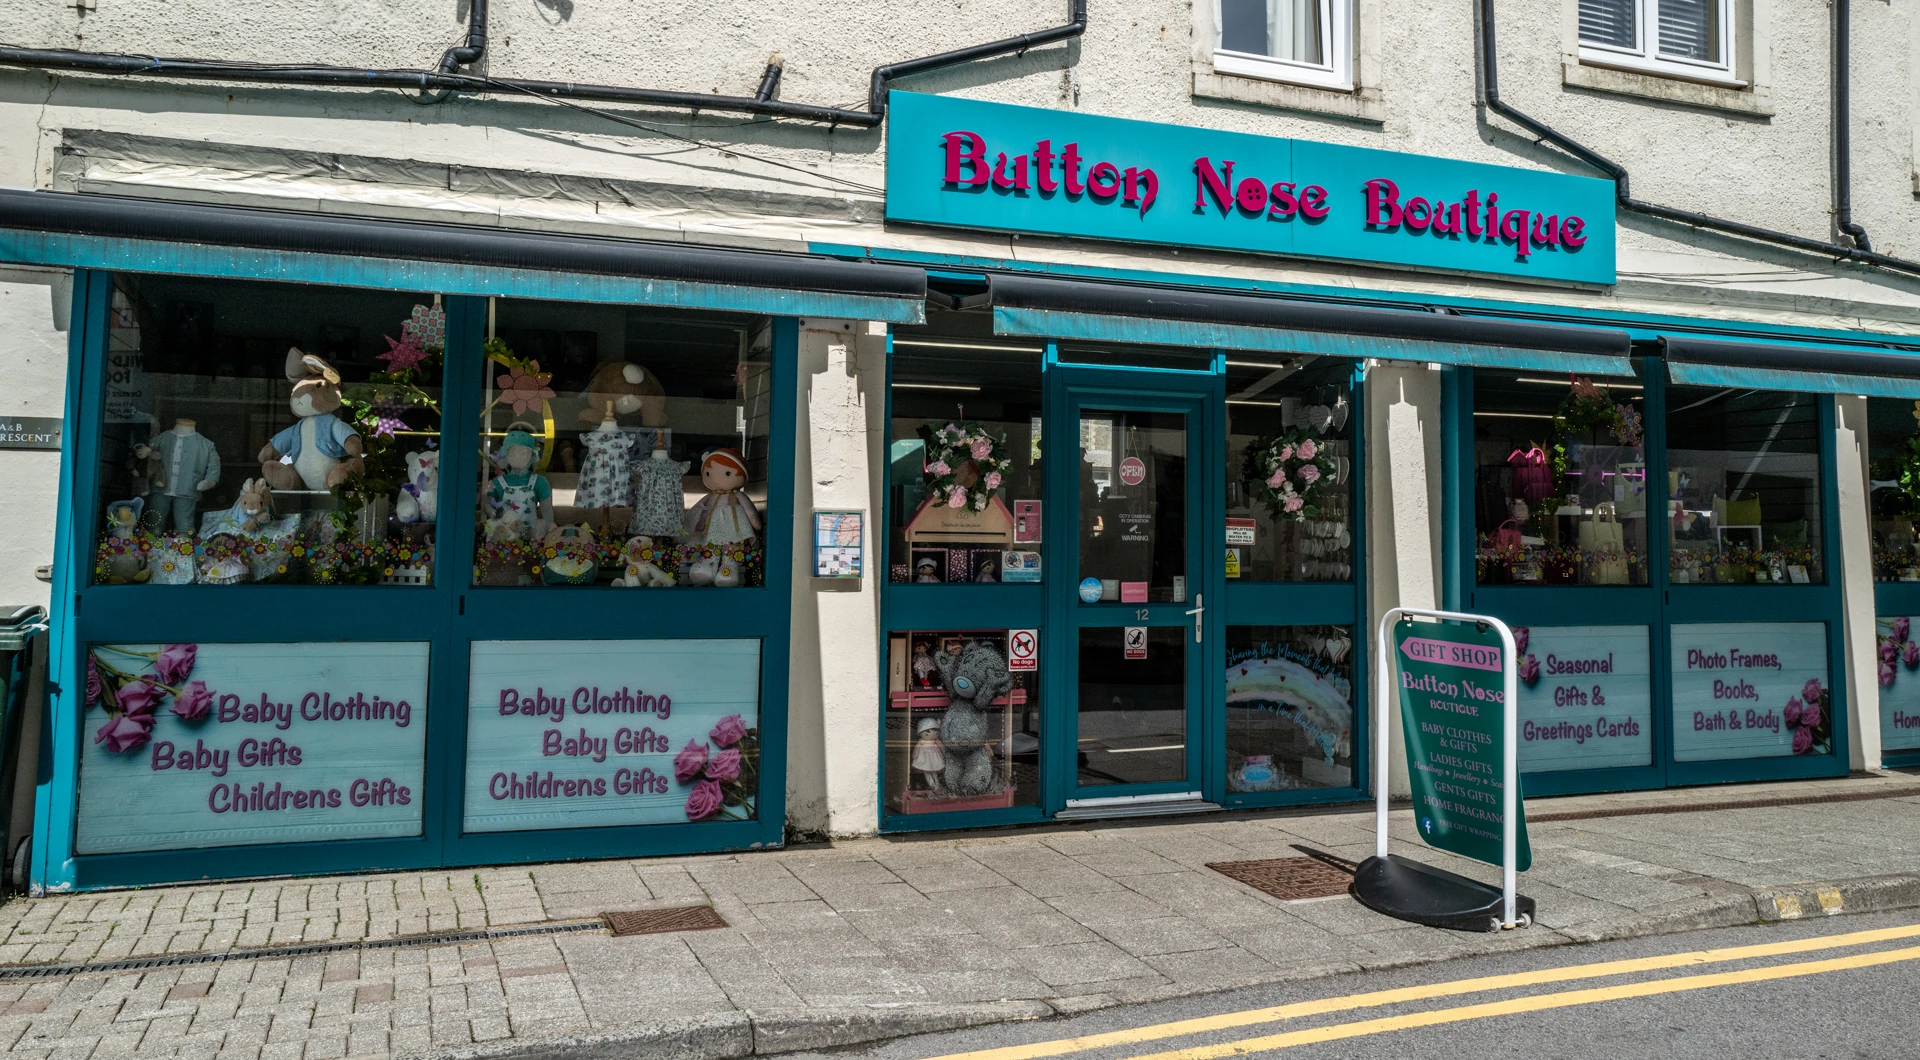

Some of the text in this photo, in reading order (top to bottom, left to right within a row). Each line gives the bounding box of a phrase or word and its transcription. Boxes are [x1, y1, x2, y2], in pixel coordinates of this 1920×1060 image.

[942, 131, 1587, 256] Button Nose Boutique
[1121, 465, 1143, 478] OPEN
[1135, 609, 1149, 620] 12
[1261, 641, 1275, 656] the
[1410, 642, 1497, 666] GIFT SHOP
[1688, 649, 1782, 671] Photo Frames,
[1546, 652, 1613, 675] Seasonal
[1402, 671, 1504, 704] Button Nose
[1554, 685, 1605, 707] Gifts &
[1713, 679, 1759, 702] Books,
[218, 692, 411, 730] Baby Clothing
[499, 687, 671, 722] Baby Clothing
[1430, 699, 1479, 716] BOUTIQUE
[1523, 716, 1640, 744] Greetings Cards
[1694, 709, 1779, 733] Bath & Body
[543, 727, 669, 763] Baby Gifts
[1422, 722, 1492, 745] BABY CLOTHES
[151, 737, 302, 777] Baby Gifts
[1440, 738, 1477, 753] & GIFTS
[1414, 761, 1444, 776] Handbags
[1452, 770, 1481, 785] Jewellery
[1430, 752, 1493, 774] LADIES GIFTS
[208, 778, 411, 813] Childrens Gifts
[489, 768, 668, 800] Childrens Gifts
[1434, 781, 1496, 805] GENTS GIFTS
[1424, 796, 1453, 812] HOME
[1454, 822, 1468, 832] GIFT
[1469, 827, 1502, 841] WRAPPING
